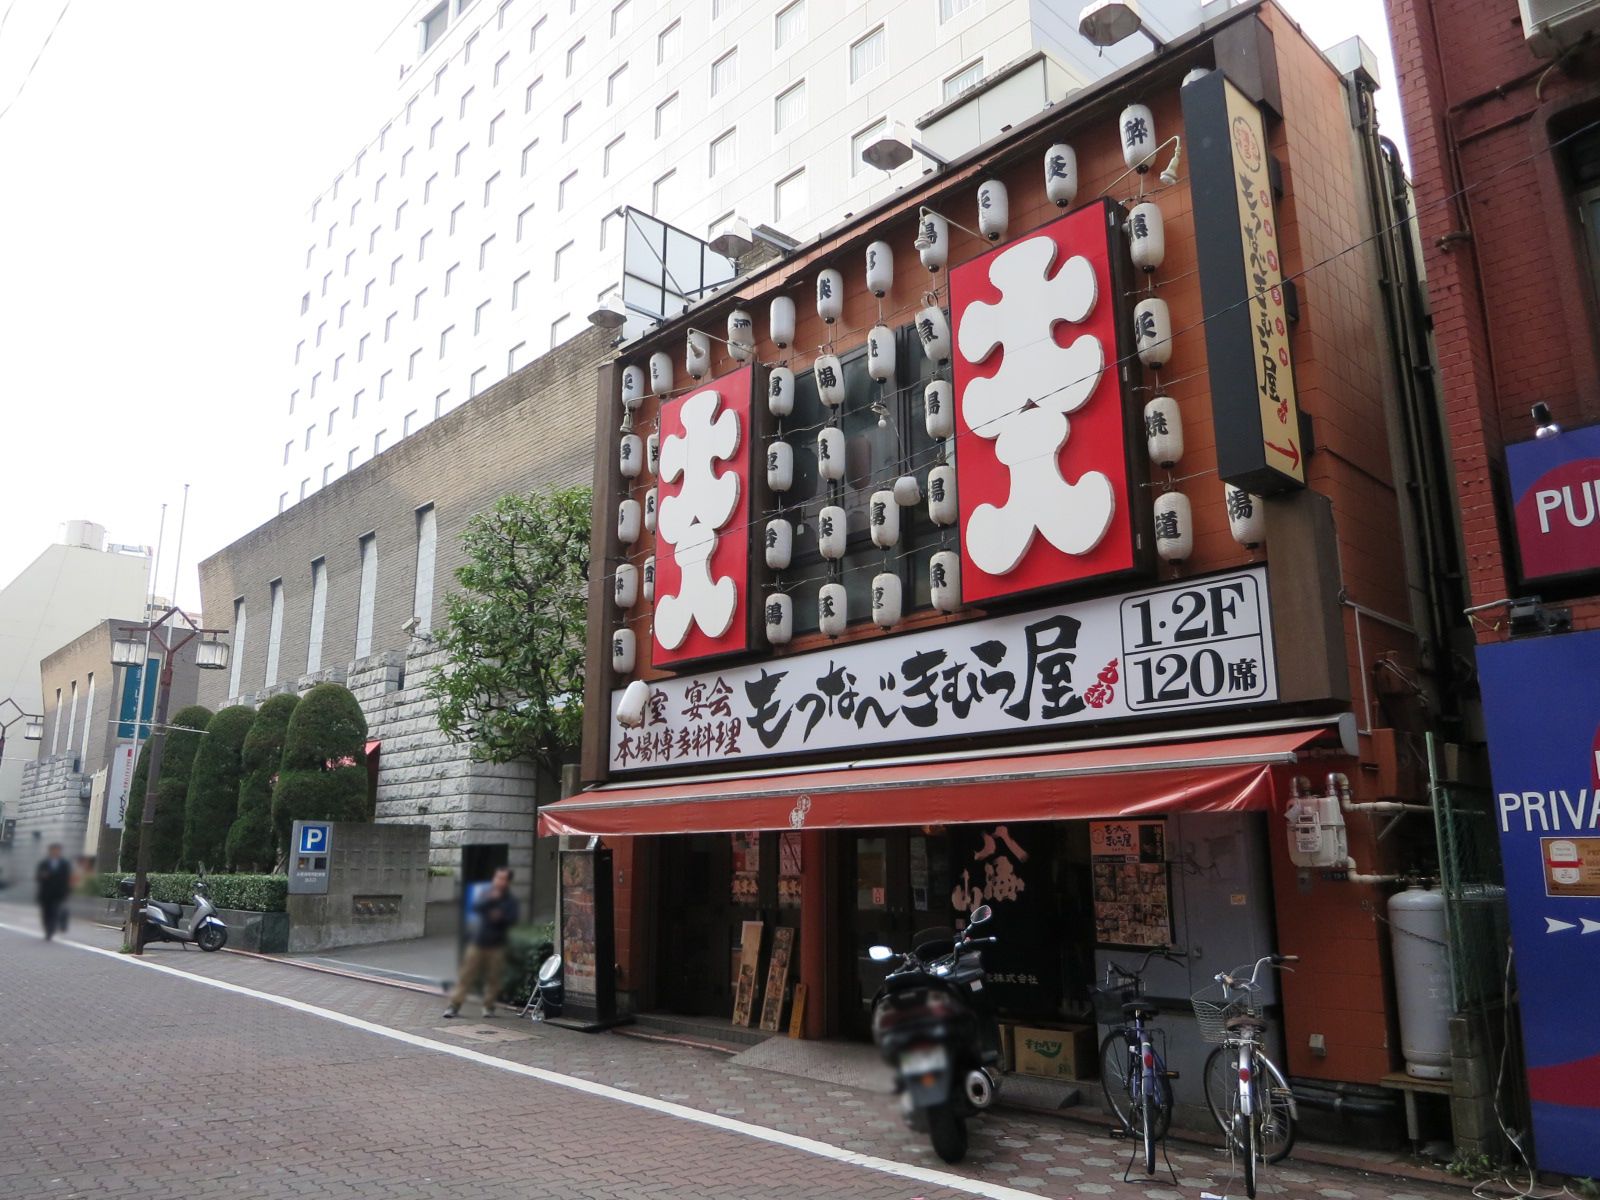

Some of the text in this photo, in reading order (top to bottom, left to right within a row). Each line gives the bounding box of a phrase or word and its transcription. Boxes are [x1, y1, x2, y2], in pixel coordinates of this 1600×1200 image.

[1155, 510, 1181, 540] 道
[1535, 480, 1600, 534] PU
[744, 615, 1087, 749] もつなべきむら屋
[1132, 648, 1258, 705] 120席
[613, 717, 742, 768] 本場博多料理
[306, 828, 323, 849] P
